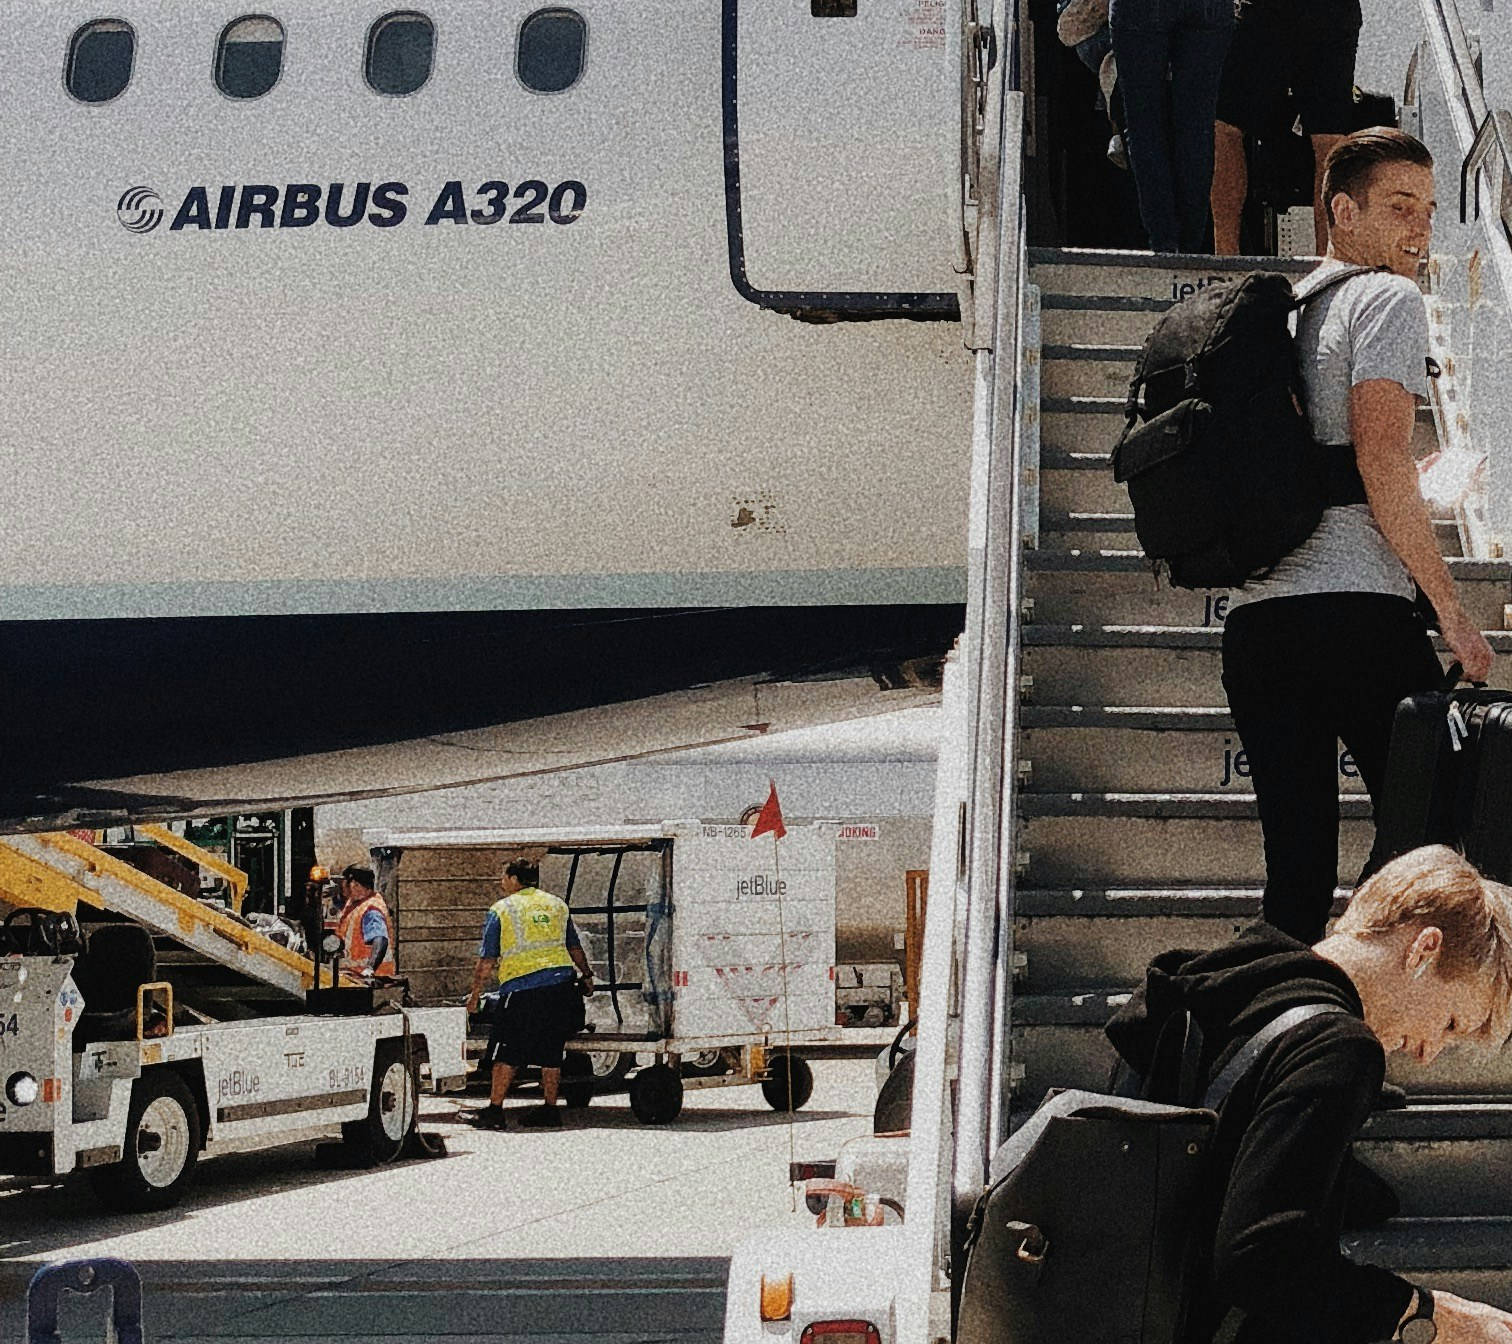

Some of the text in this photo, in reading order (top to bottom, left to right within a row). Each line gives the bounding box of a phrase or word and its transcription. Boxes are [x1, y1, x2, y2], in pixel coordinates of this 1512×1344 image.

[170, 179, 588, 231] AIRBUS A320
[735, 874, 787, 901] jetBlue
[215, 1069, 261, 1105] jetBlue
